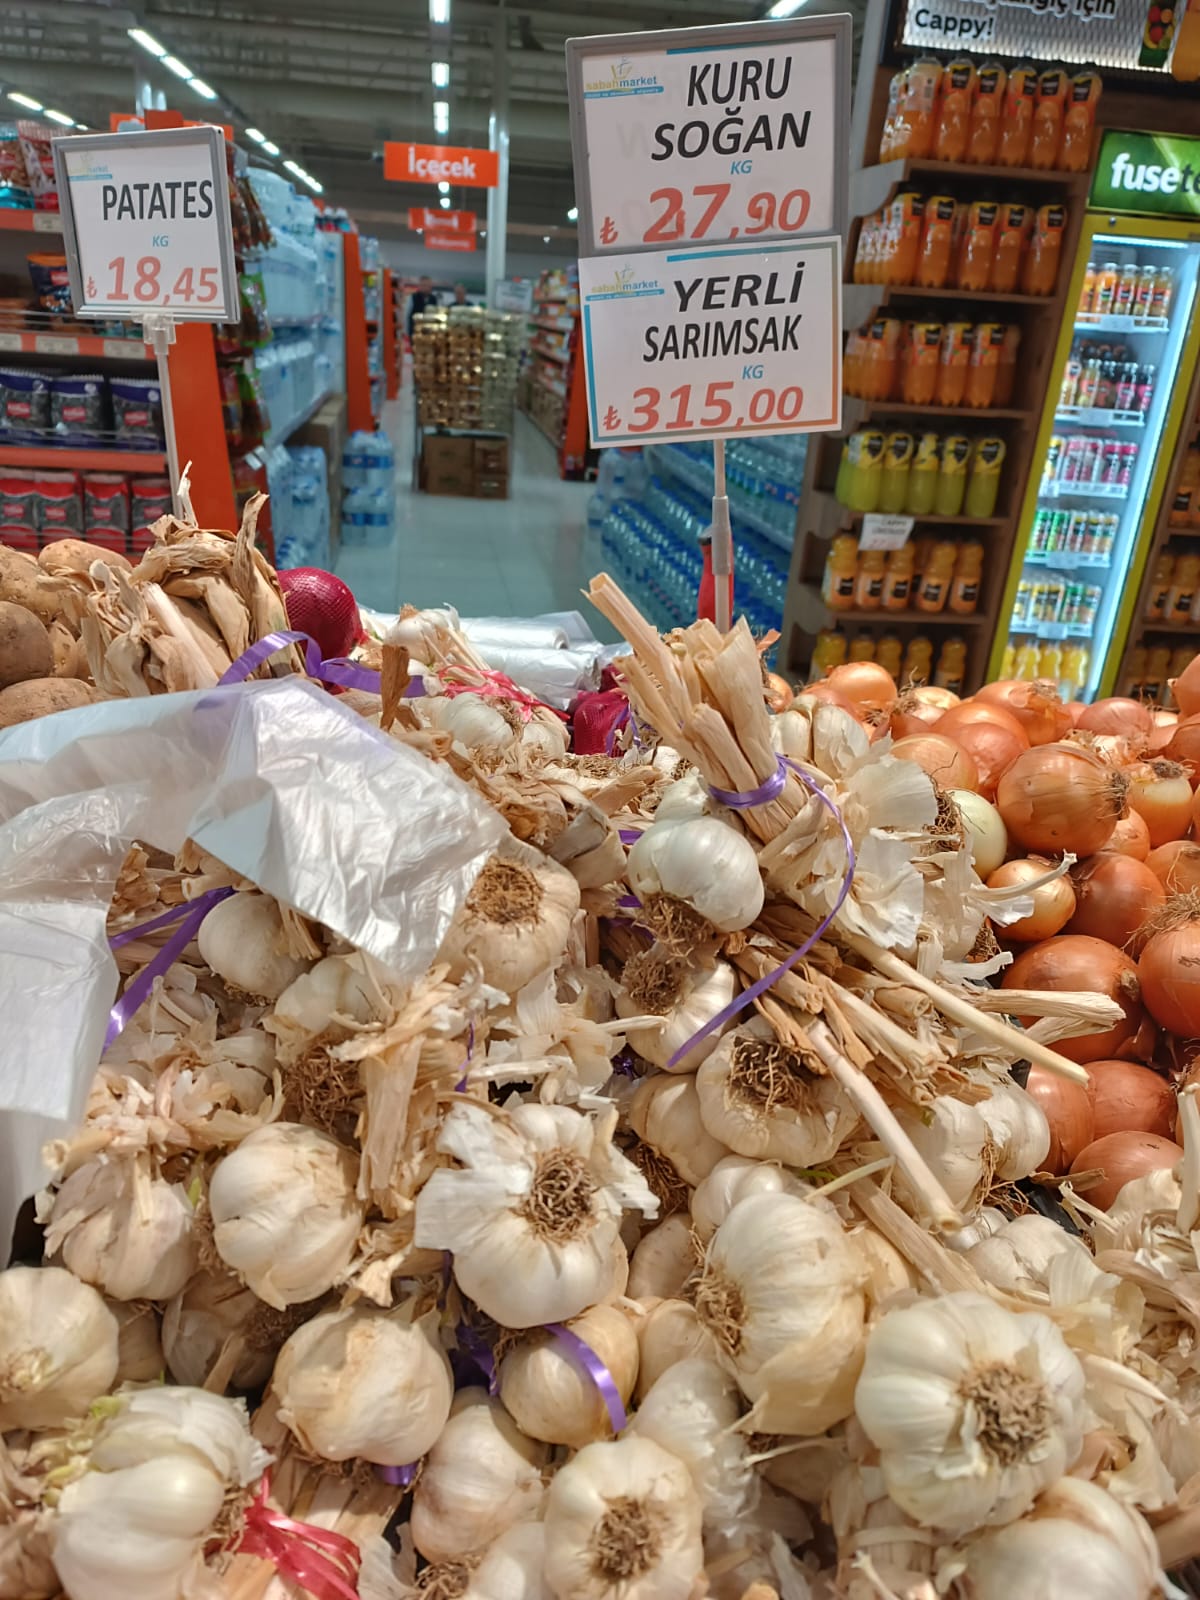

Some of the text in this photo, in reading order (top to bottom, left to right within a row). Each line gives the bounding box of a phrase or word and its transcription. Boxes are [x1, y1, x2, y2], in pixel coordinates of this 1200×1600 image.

[915, 8, 994, 39] Cappy!
[585, 75, 657, 91] sabahmarket
[687, 56, 793, 107] KURU
[651, 106, 812, 161] SOĞAN
[408, 145, 477, 179] İçecek
[730, 159, 753, 175] KG
[103, 179, 213, 221] PATATES
[642, 183, 812, 243] 27,90
[152, 234, 169, 248] KG
[106, 255, 219, 307] 18,45
[673, 261, 806, 313] YERLİ
[642, 314, 803, 363] SARIMSAK
[742, 364, 765, 380] KG
[627, 381, 804, 432] 315,00
